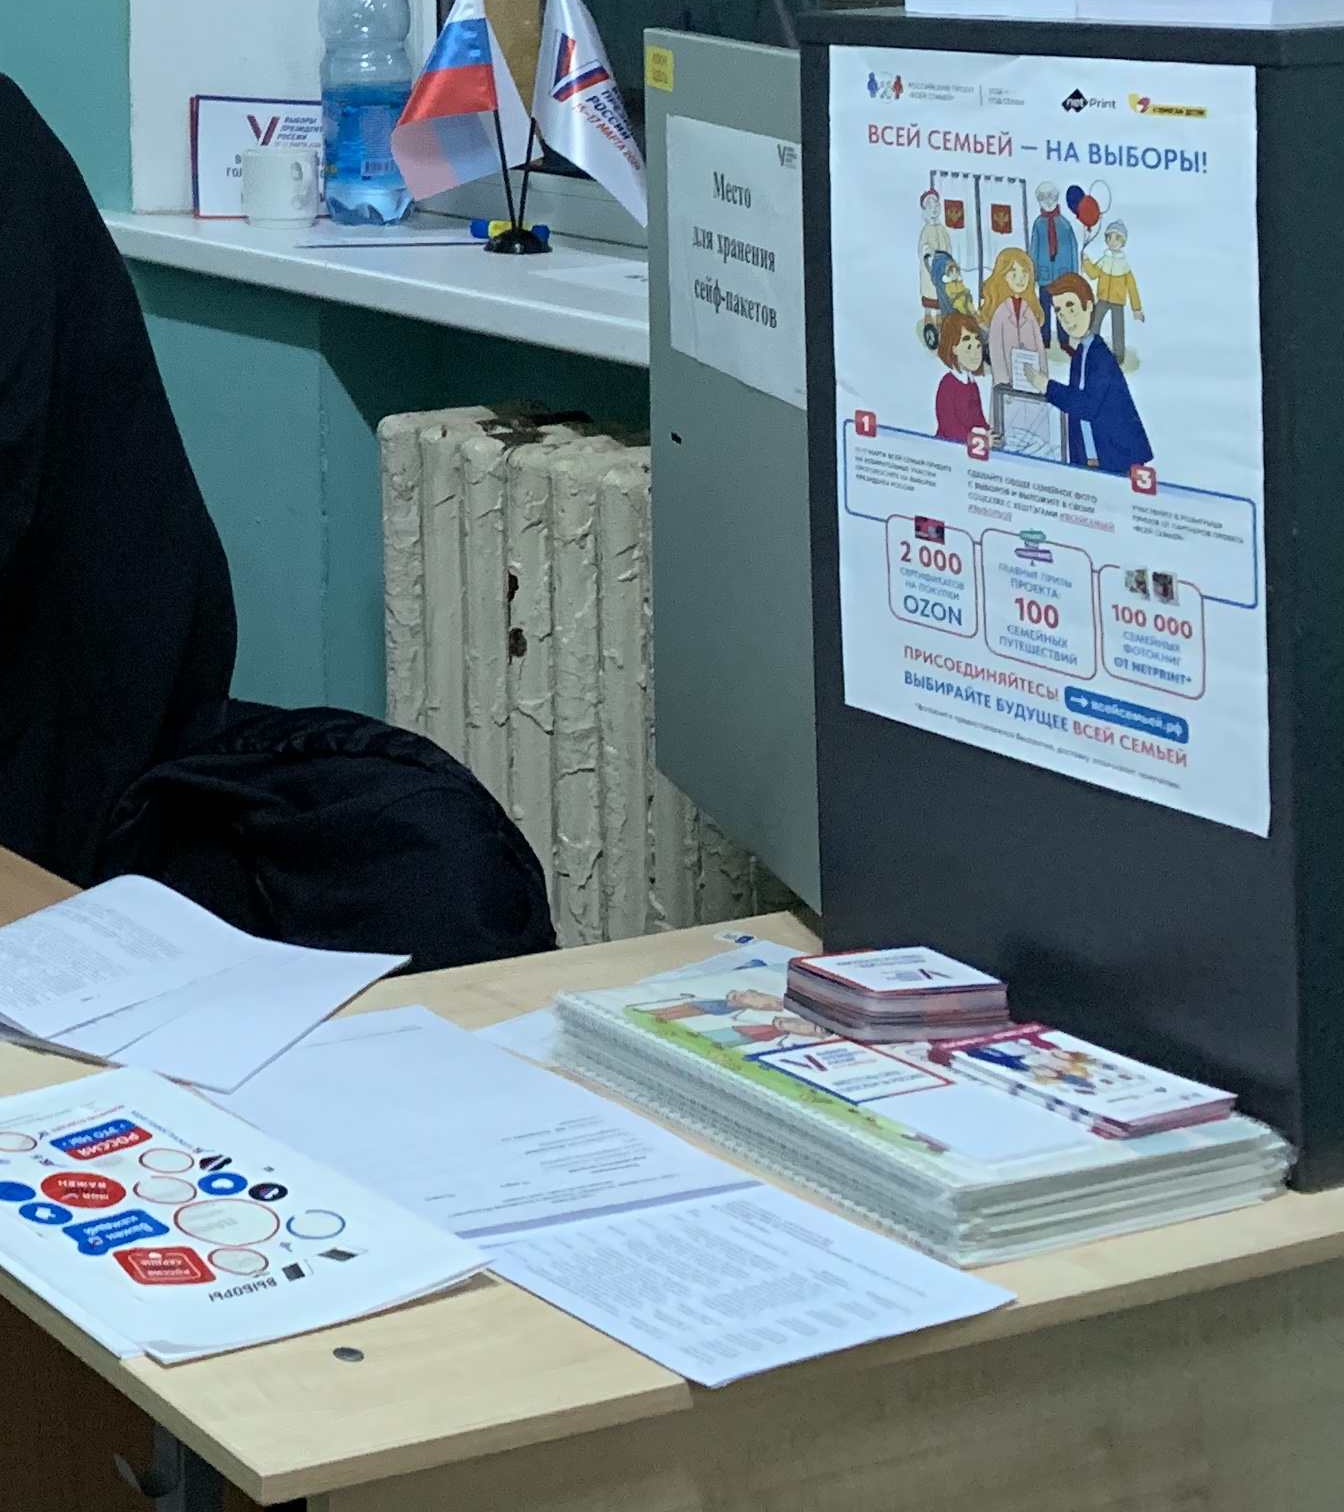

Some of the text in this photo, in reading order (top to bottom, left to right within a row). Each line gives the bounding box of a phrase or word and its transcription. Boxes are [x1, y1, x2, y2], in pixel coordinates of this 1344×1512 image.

[586, 95, 630, 140] РОССИИ
[868, 123, 920, 148] ВСЕЙ
[928, 130, 1013, 158] СЕМЬЕЙ
[1046, 140, 1080, 163] НА
[1088, 143, 1207, 173] ВЫБОРЫ!
[712, 171, 752, 209] Место
[692, 226, 776, 273] для хранения
[694, 275, 777, 329] сейф-пакетов
[861, 415, 870, 432] 1
[971, 438, 985, 455] 2
[1136, 470, 1152, 489] 3
[900, 540, 962, 575] 2 000
[902, 594, 962, 626] OZON
[1014, 597, 1059, 629] 100
[1111, 603, 1193, 639] 100 000
[998, 635, 1078, 666] ПУТЕШЕСТВИЙ
[1006, 624, 1068, 649] СЕМЕЙНЫХ
[904, 644, 1059, 701] ПРИСОЕДИНЯЙТЕСЬ!
[1113, 657, 1130, 670] ОТ
[904, 670, 1188, 768] ВЫБИРАЙТЕ БУДУЩЕЕ ВСЕЙ СЕМЬЕЙ
[76, 1132, 139, 1156] РОССИЯ
[208, 1277, 277, 1302] ВЫБОРЫ
